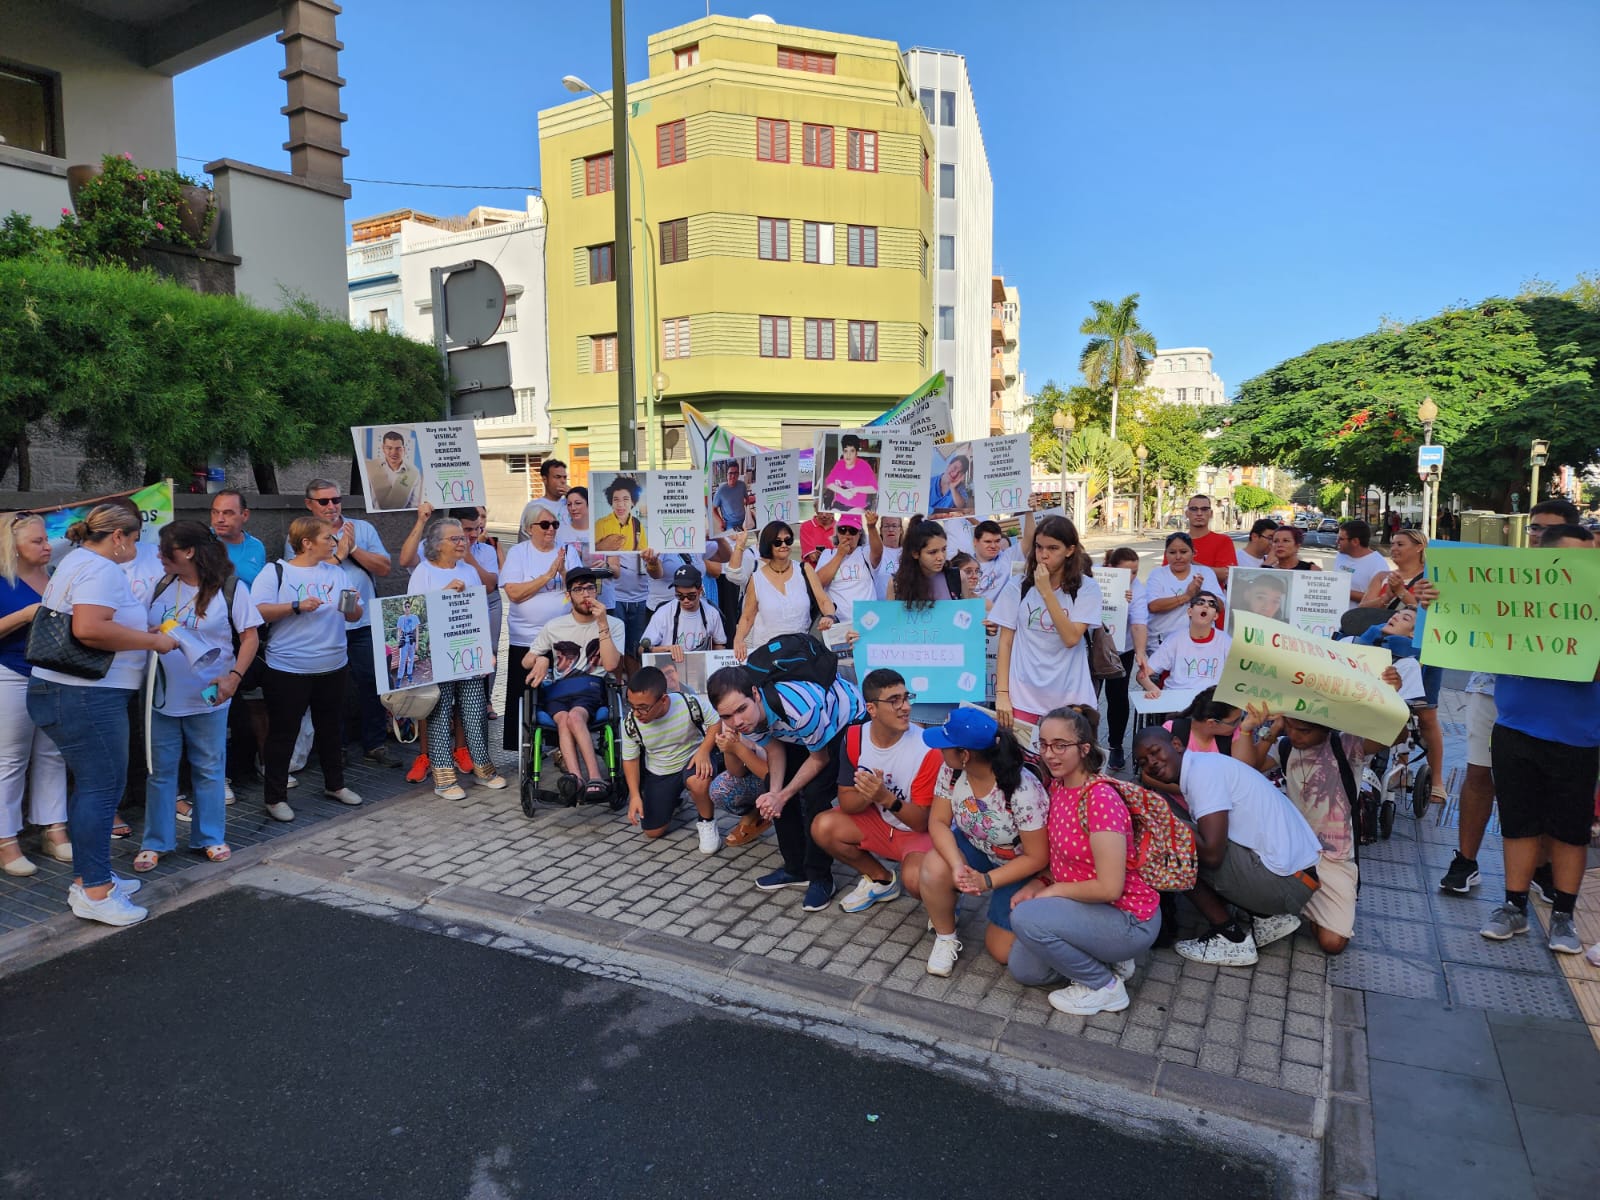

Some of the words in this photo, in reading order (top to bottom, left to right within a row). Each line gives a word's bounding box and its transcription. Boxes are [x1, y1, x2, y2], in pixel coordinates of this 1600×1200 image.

[1433, 566, 1458, 584] LA
[1469, 558, 1573, 585] INCLUSIÓN
[1434, 602, 1450, 615] ES
[1461, 603, 1481, 616] UN
[1244, 626, 1265, 646] UN
[1272, 633, 1325, 657] CENTRO
[1430, 628, 1458, 645] NO
[1469, 630, 1495, 649] UN
[1508, 634, 1578, 655] FAVOR
[1234, 683, 1283, 704] CADA
[1239, 658, 1278, 679] UNA
[1291, 671, 1385, 704] SONRISA
